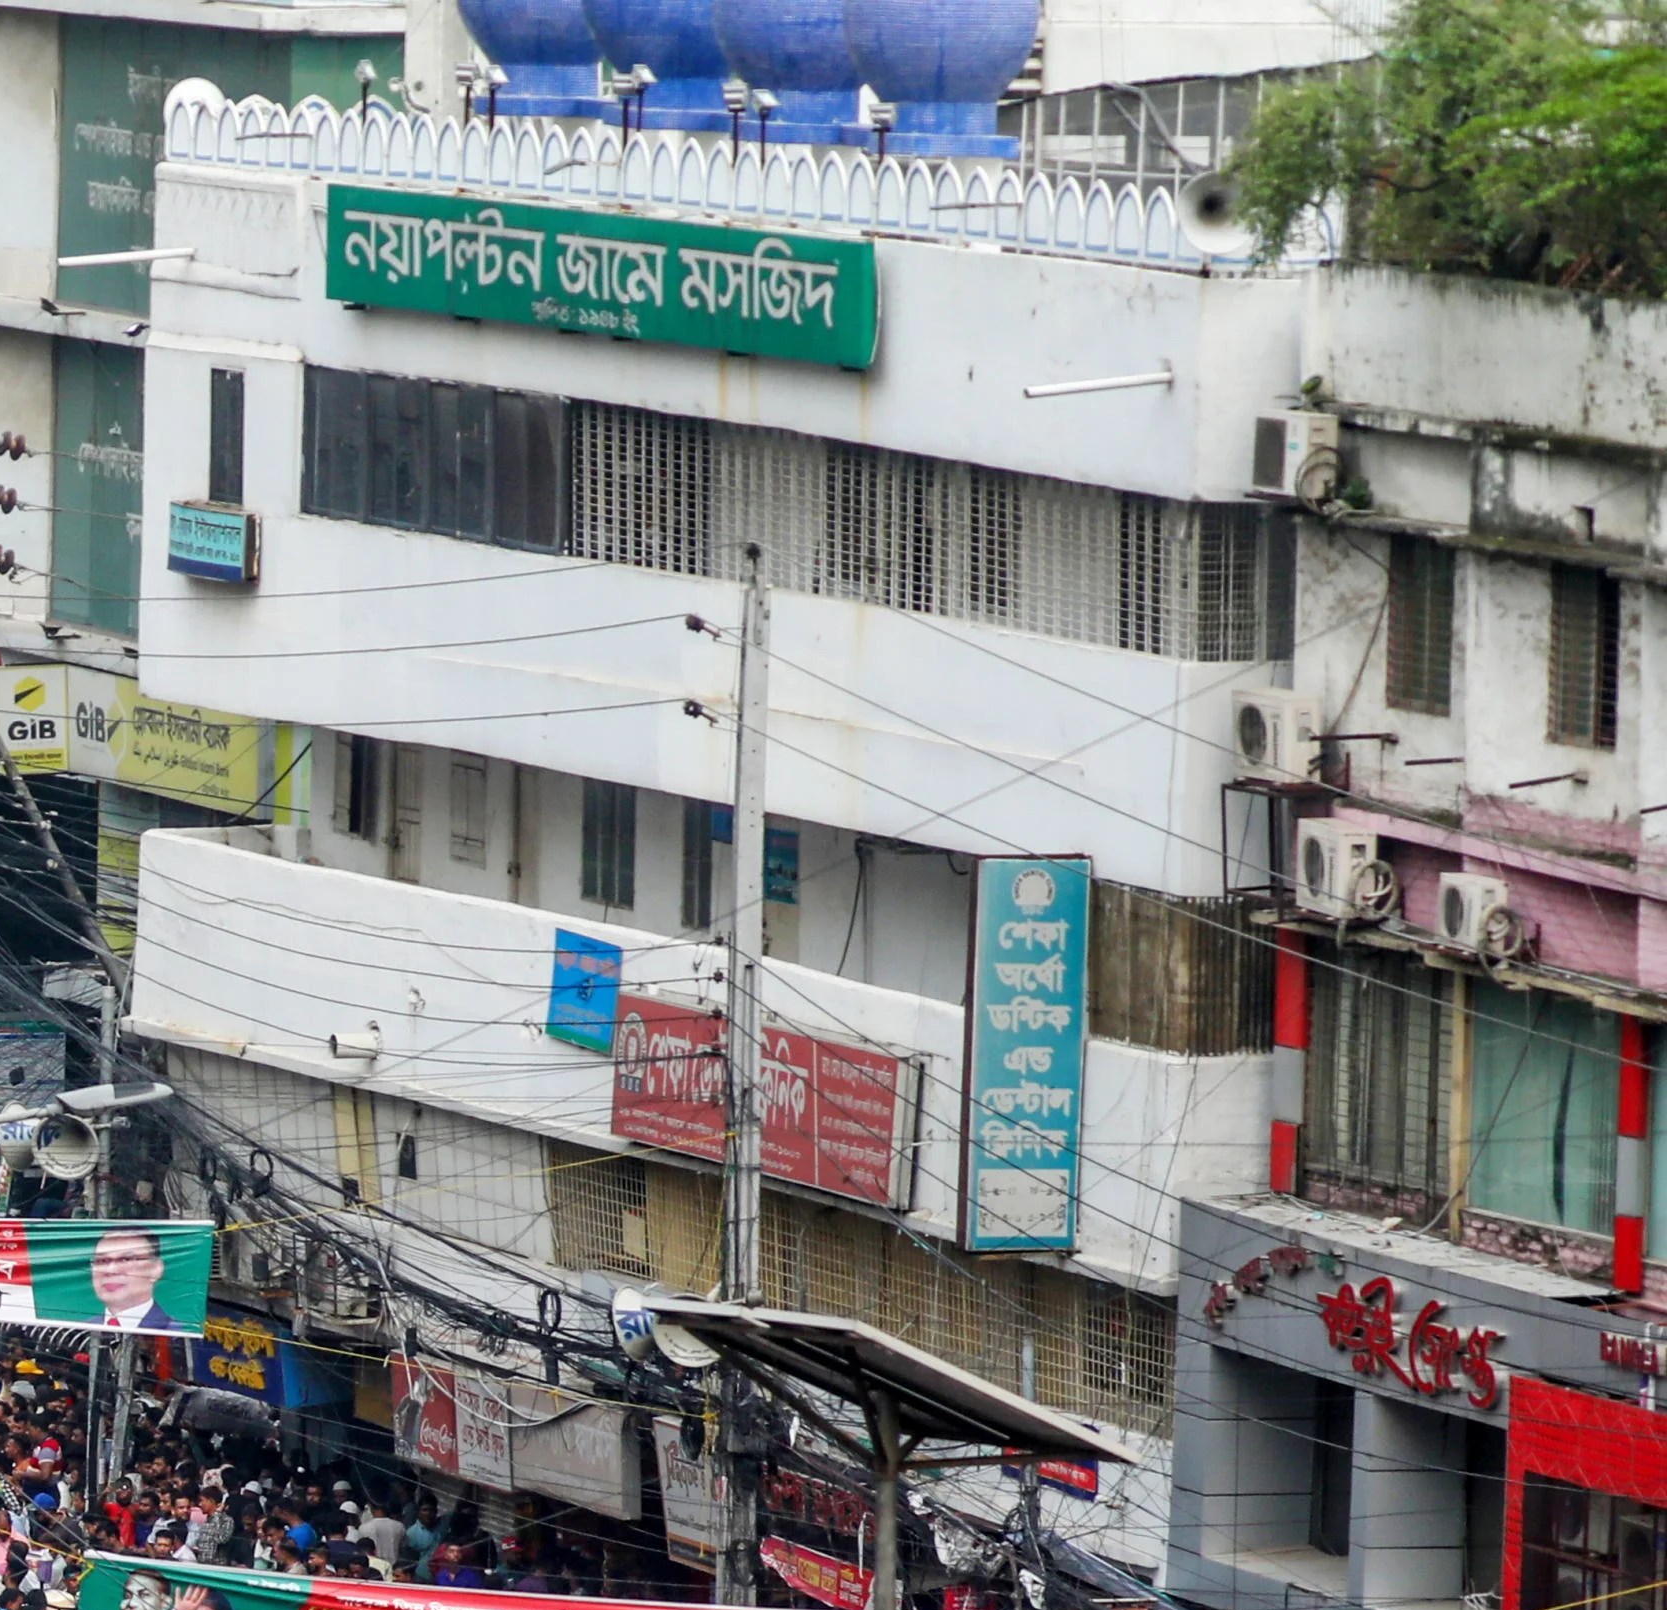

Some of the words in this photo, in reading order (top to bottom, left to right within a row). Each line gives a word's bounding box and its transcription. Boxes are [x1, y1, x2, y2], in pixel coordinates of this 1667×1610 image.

[343, 207, 545, 294] নয়াপল্টন
[556, 232, 667, 307] জামে
[678, 237, 839, 328] মসজিদ
